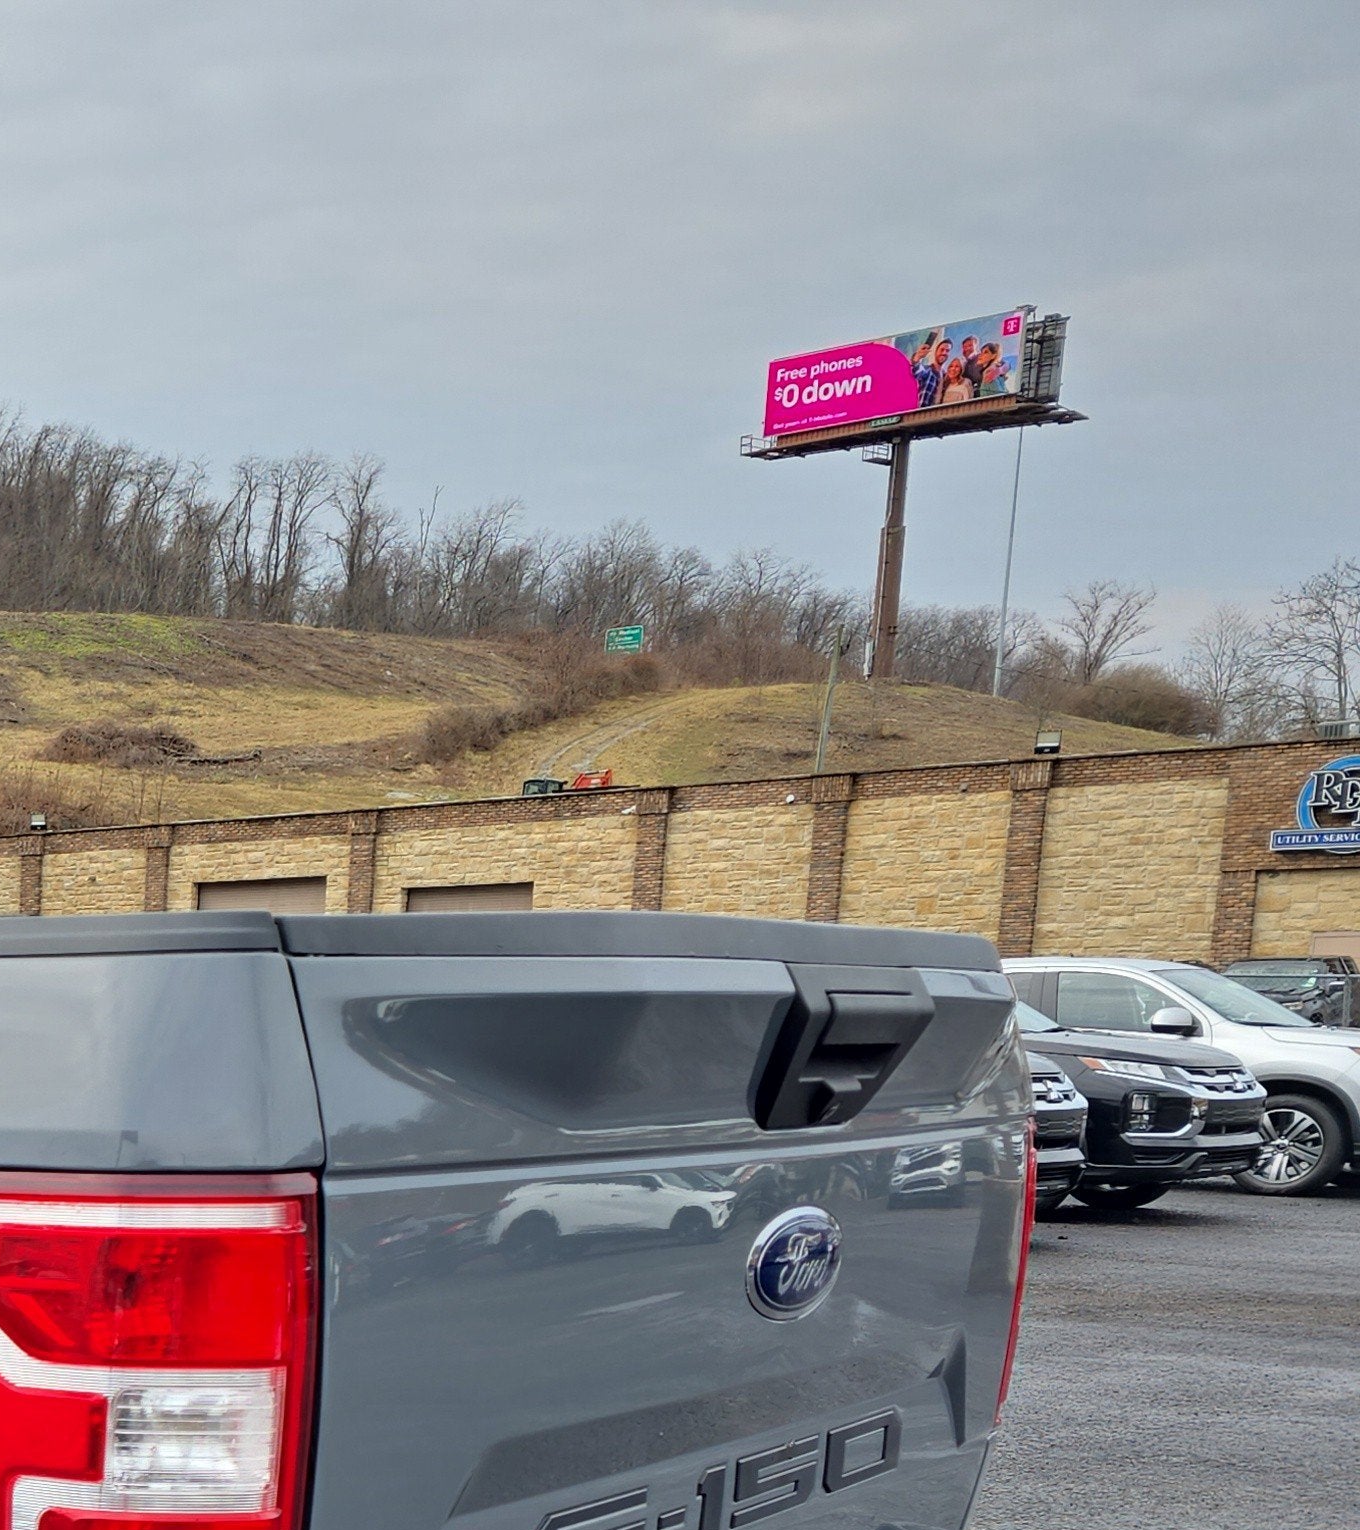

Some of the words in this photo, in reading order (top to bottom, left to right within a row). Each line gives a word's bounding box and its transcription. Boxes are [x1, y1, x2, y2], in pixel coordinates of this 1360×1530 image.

[776, 367, 807, 382] Free
[810, 355, 863, 379] phones
[774, 383, 799, 408] $0
[802, 374, 872, 404] down
[1277, 834, 1321, 844] UTILITY
[774, 1231, 832, 1297] Ford
